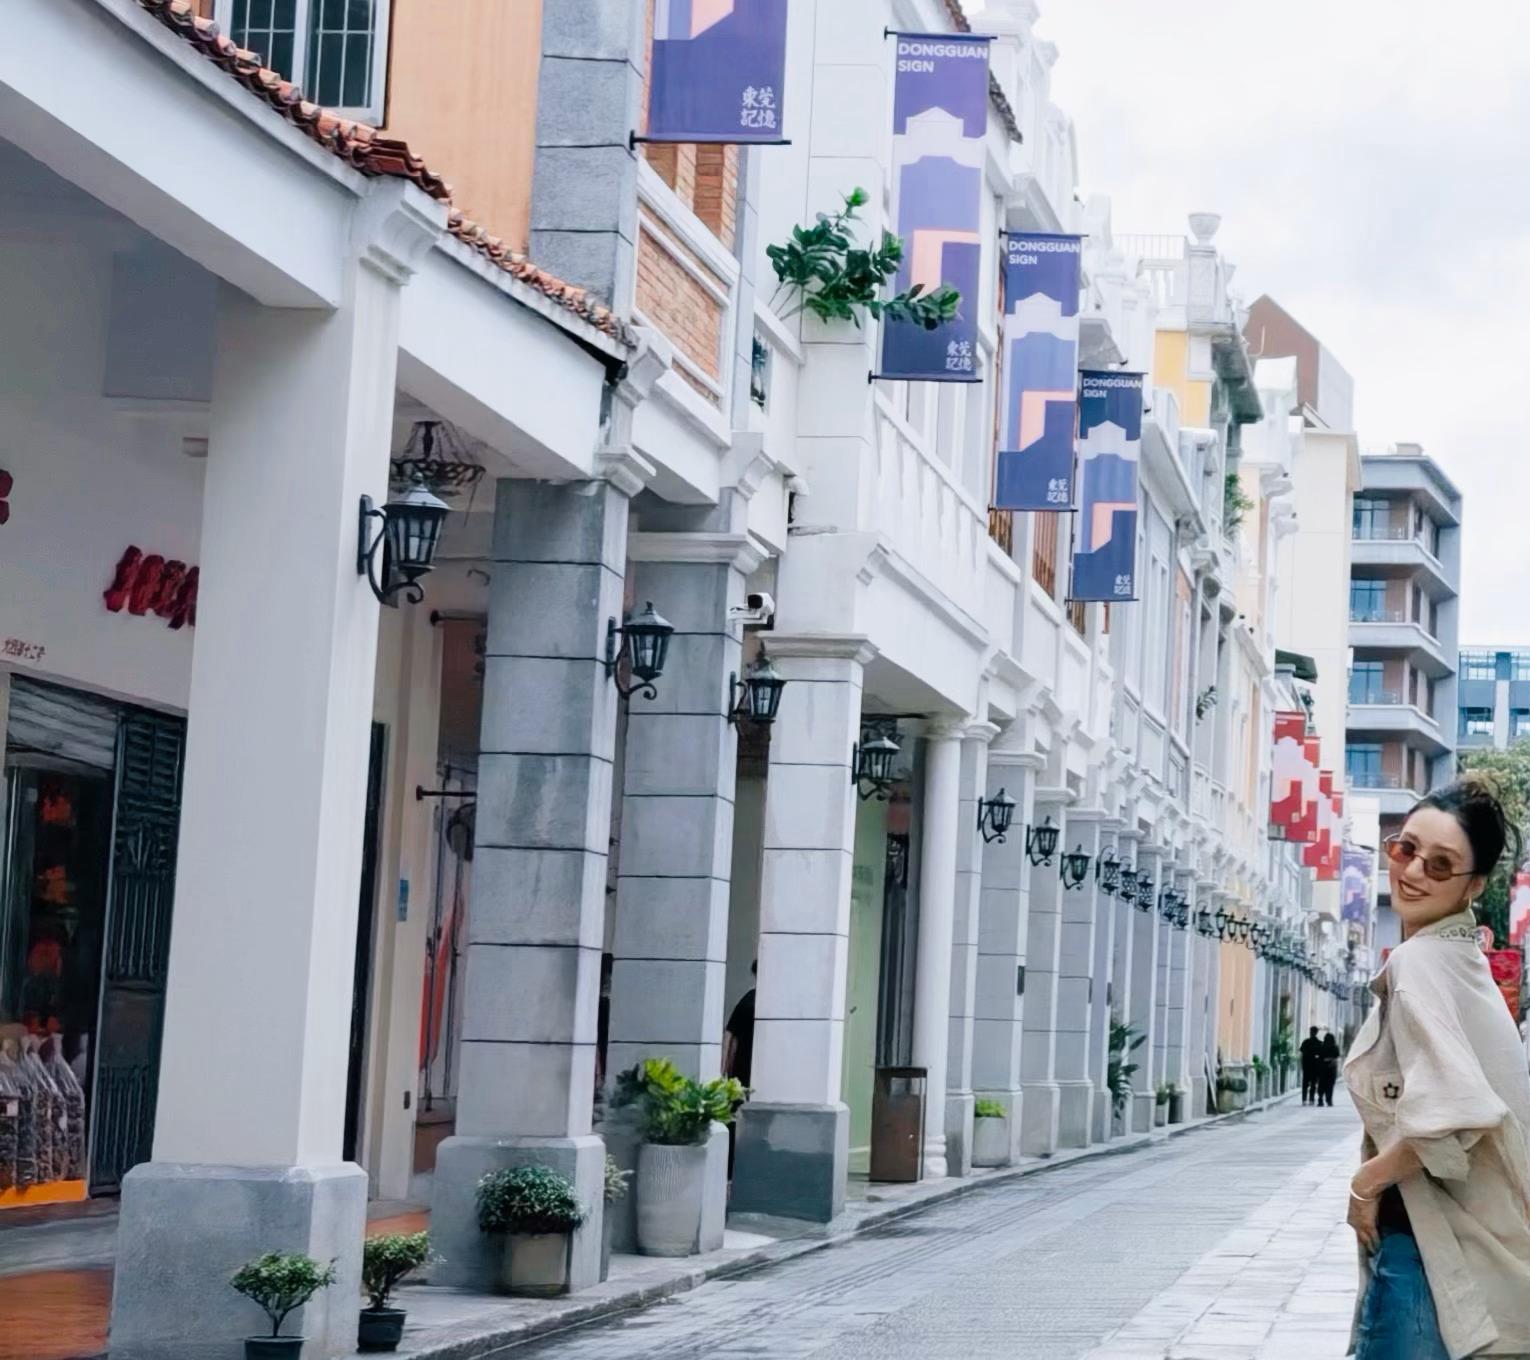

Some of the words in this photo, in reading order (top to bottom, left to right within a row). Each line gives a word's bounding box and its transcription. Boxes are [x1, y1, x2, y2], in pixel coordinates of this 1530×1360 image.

[898, 42, 988, 59] DONGGUAN
[898, 60, 934, 73] SIGN
[1008, 240, 1081, 253] DONGGUAN
[1008, 254, 1038, 265] SIGN
[1083, 378, 1142, 389] DONGGUAN
[1083, 389, 1108, 398] SIGN
